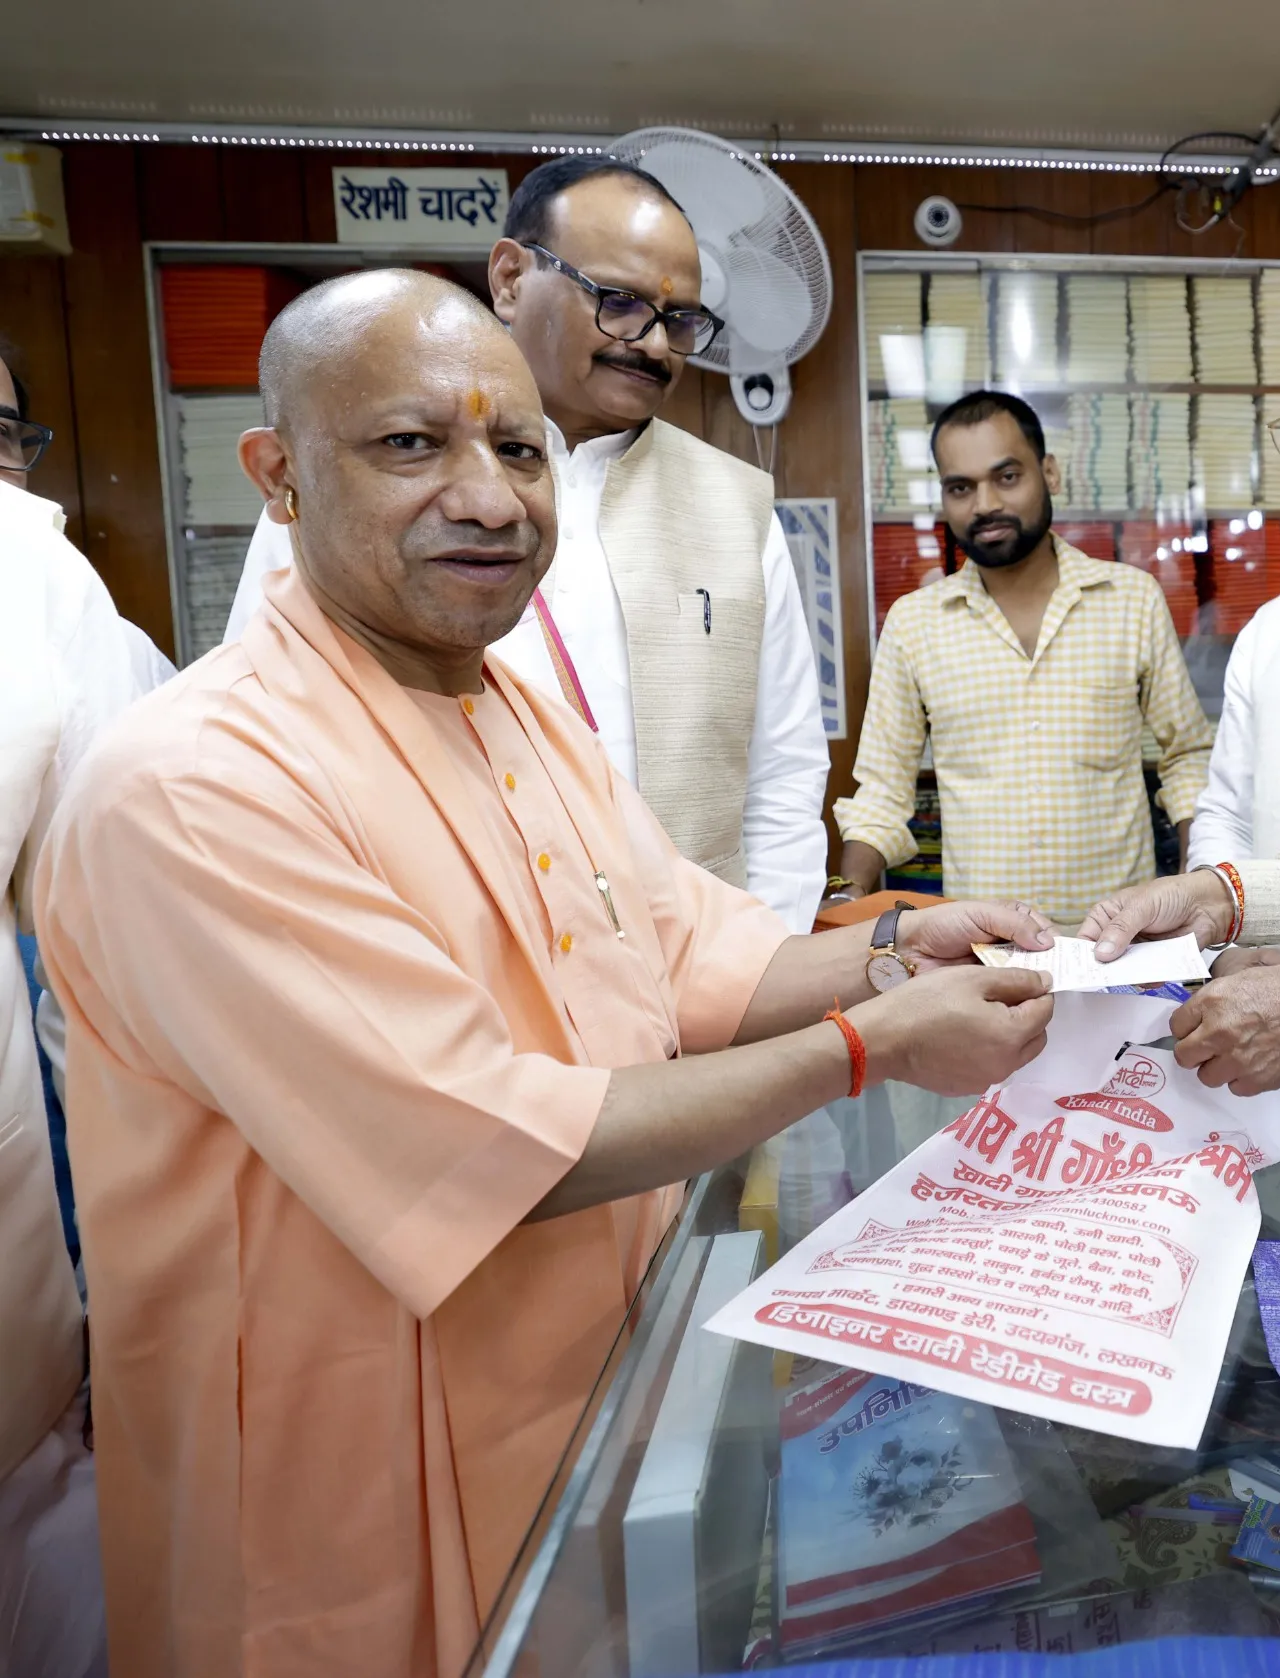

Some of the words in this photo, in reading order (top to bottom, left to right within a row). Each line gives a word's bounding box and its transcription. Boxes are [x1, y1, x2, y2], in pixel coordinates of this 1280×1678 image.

[339, 175, 409, 220] रेशमी
[417, 177, 501, 226] चादरें
[1065, 1096, 1112, 1110] Khadi
[1113, 1101, 1157, 1128] India
[1012, 1117, 1064, 1181] श्री
[953, 1159, 1013, 1192] खादी
[768, 1304, 889, 1344] डिजाइनर
[892, 1327, 966, 1364] खादी
[970, 1344, 1064, 1393] रेडीमेड
[1097, 1348, 1176, 1381] लखनऊ
